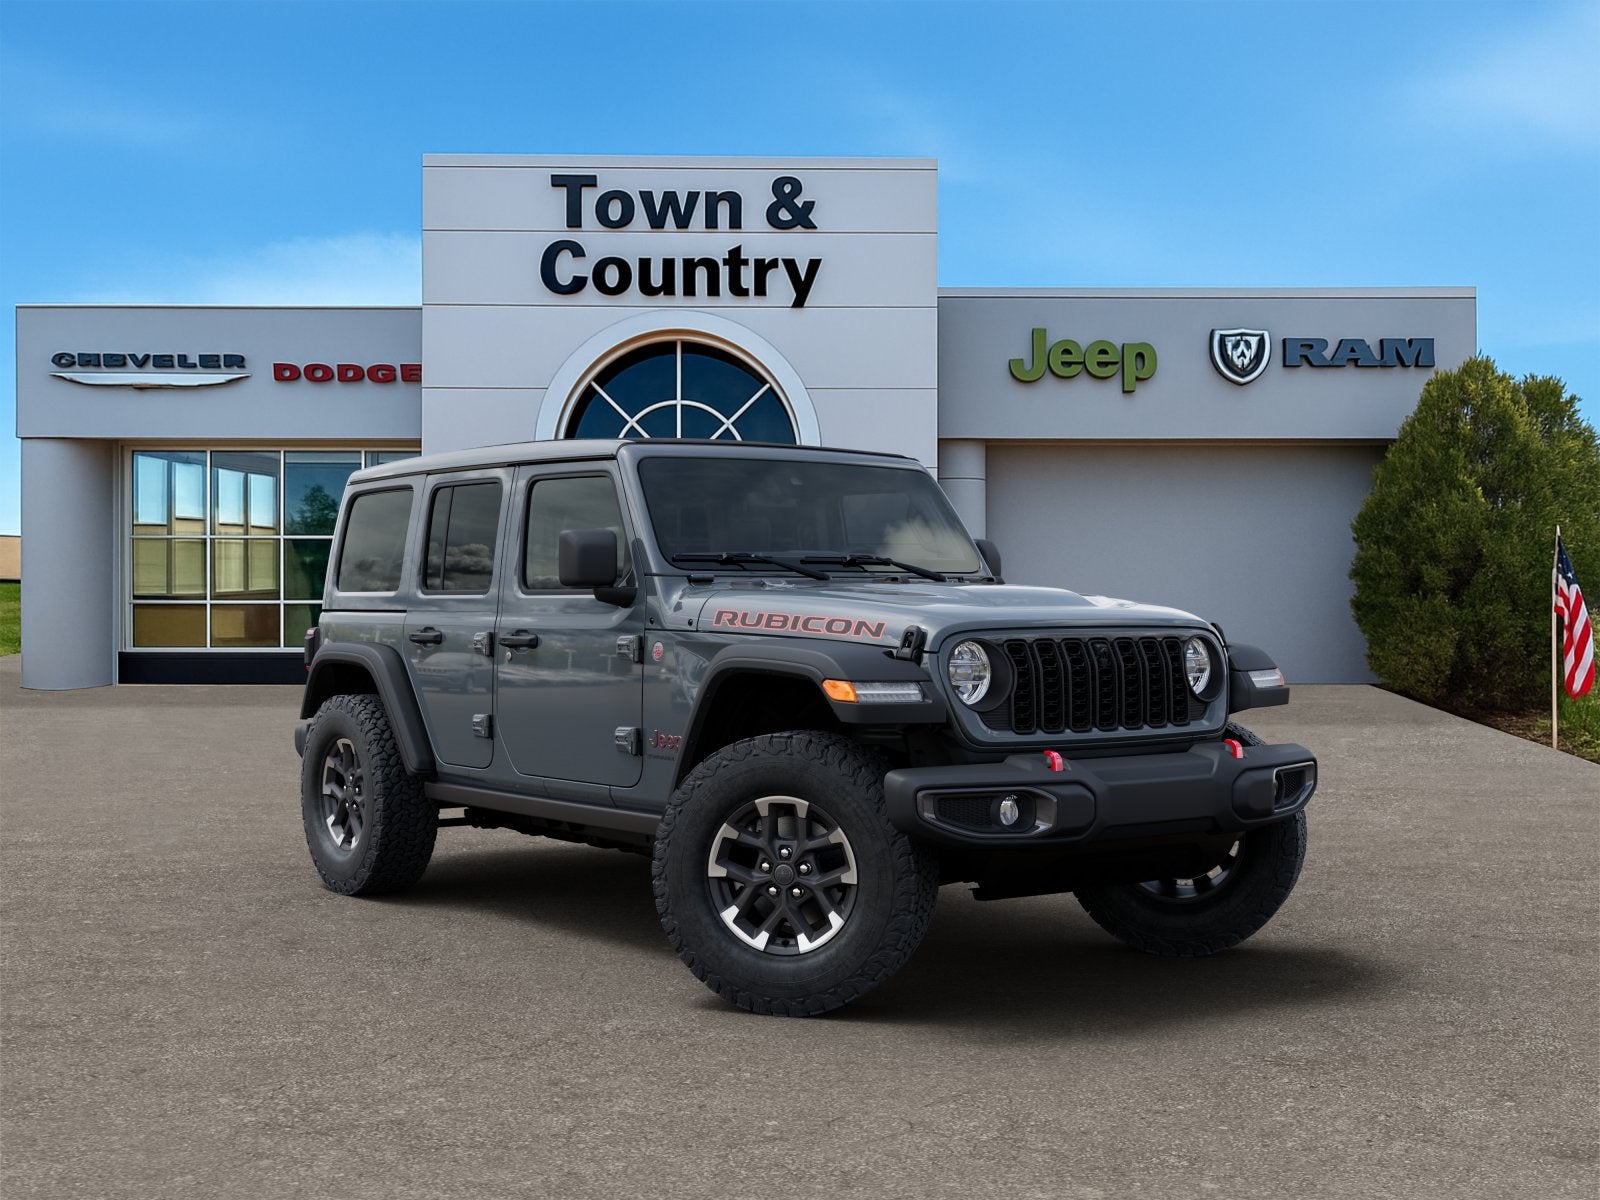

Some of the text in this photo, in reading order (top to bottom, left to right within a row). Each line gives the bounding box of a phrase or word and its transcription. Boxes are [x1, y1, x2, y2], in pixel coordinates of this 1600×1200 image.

[550, 174, 818, 230] Town &
[540, 239, 822, 308] Country
[273, 363, 422, 383] DODGE
[1009, 328, 1157, 392] Jeep
[1283, 337, 1435, 368] RAM
[714, 609, 887, 638] RUBICON
